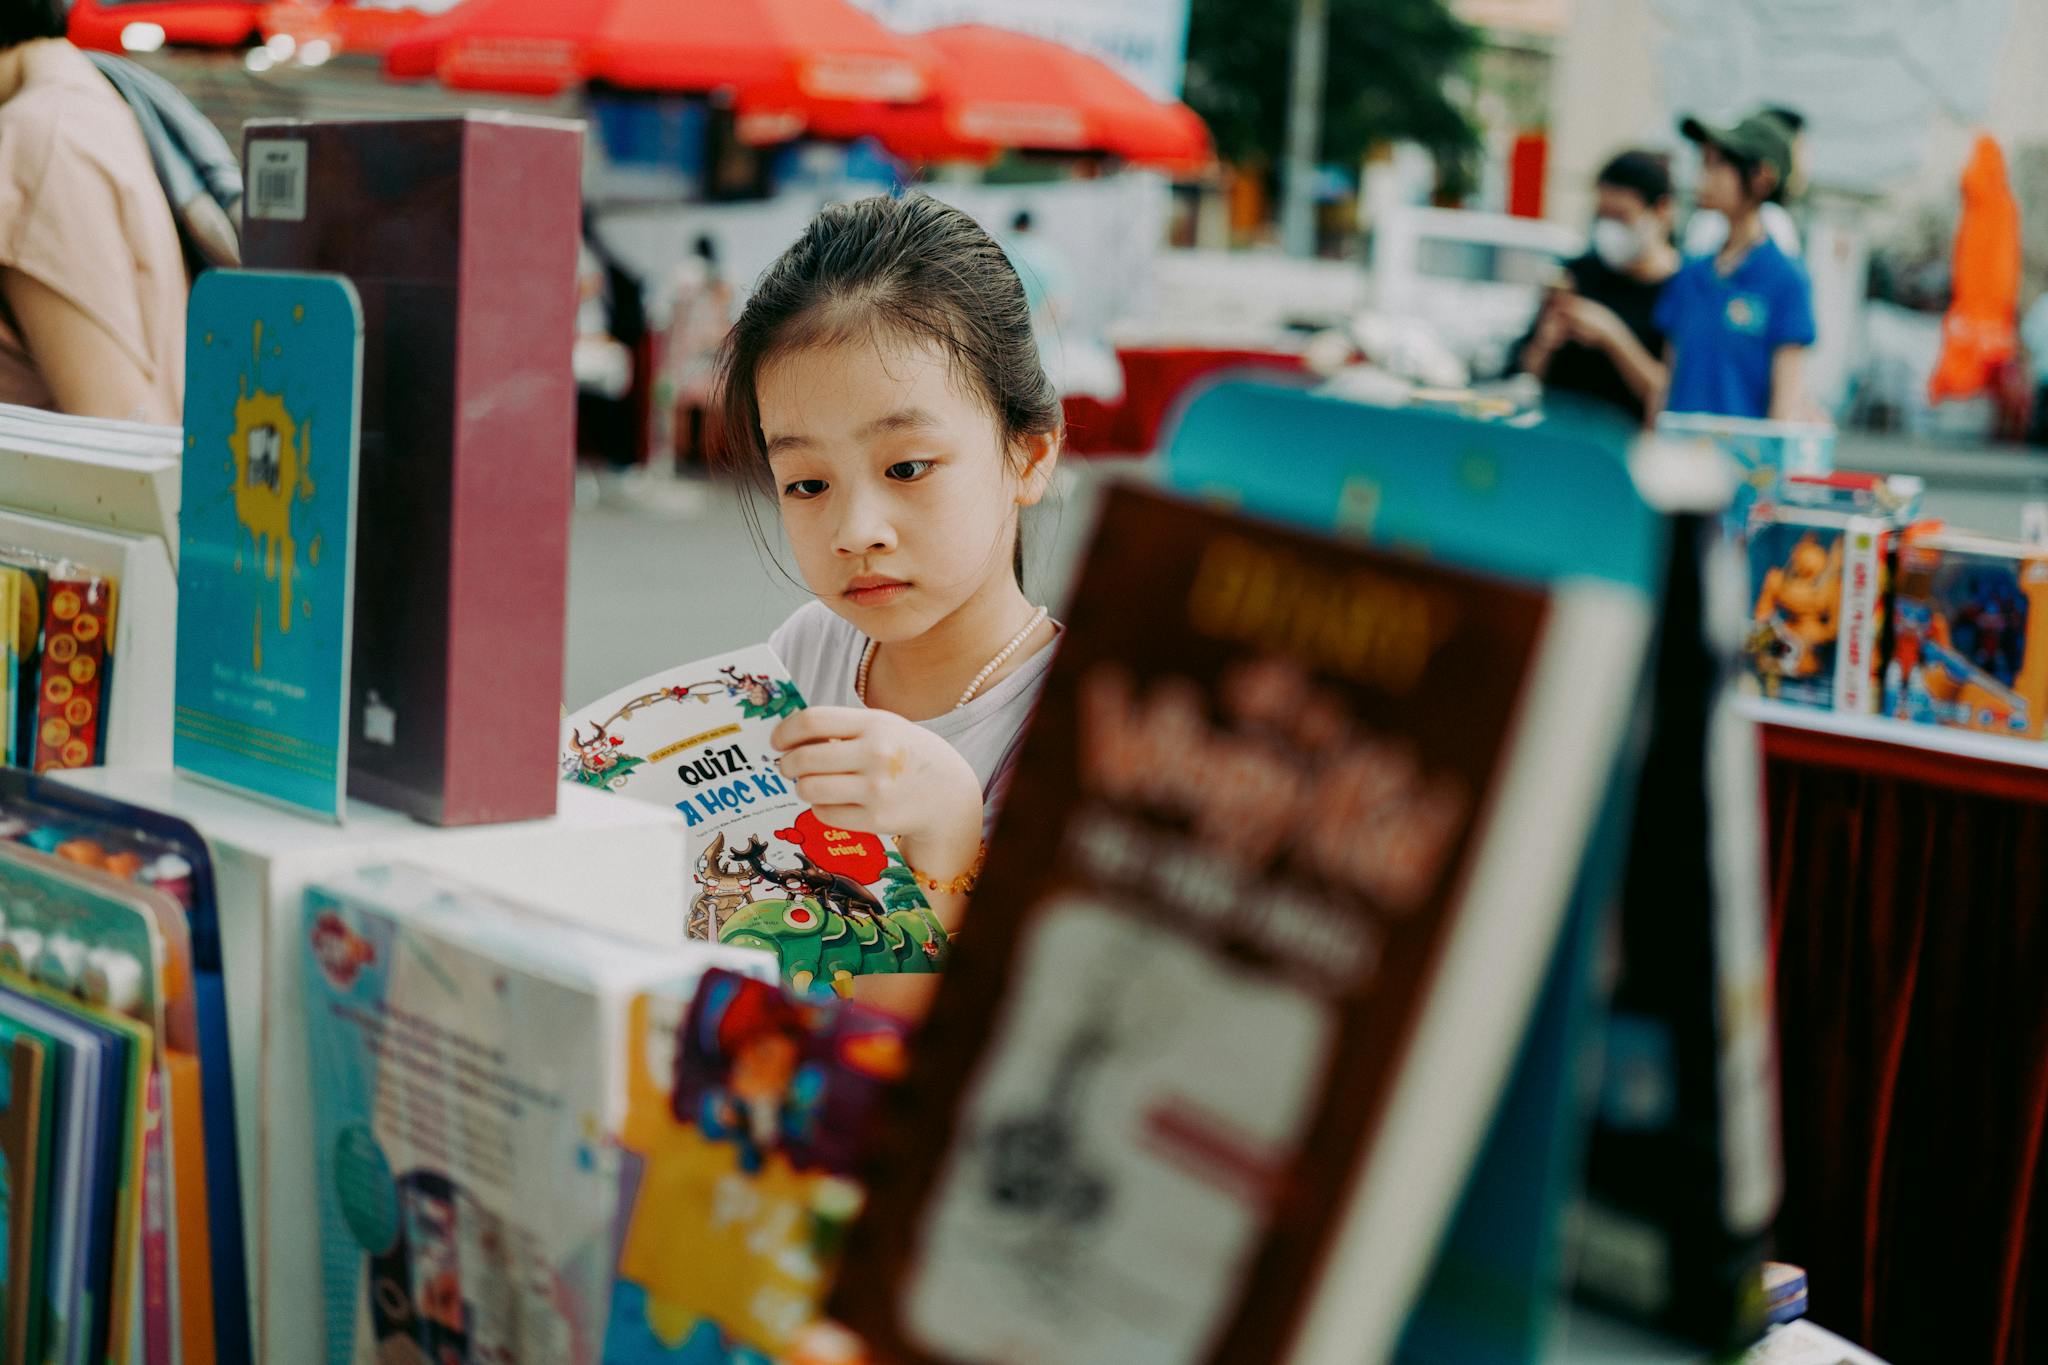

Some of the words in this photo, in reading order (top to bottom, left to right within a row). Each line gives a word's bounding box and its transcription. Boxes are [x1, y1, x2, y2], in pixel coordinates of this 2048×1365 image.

[695, 780, 755, 814] HỌC
[750, 767, 788, 797] KÌ
[823, 829, 852, 842] Côn
[827, 843, 868, 857] trùng
